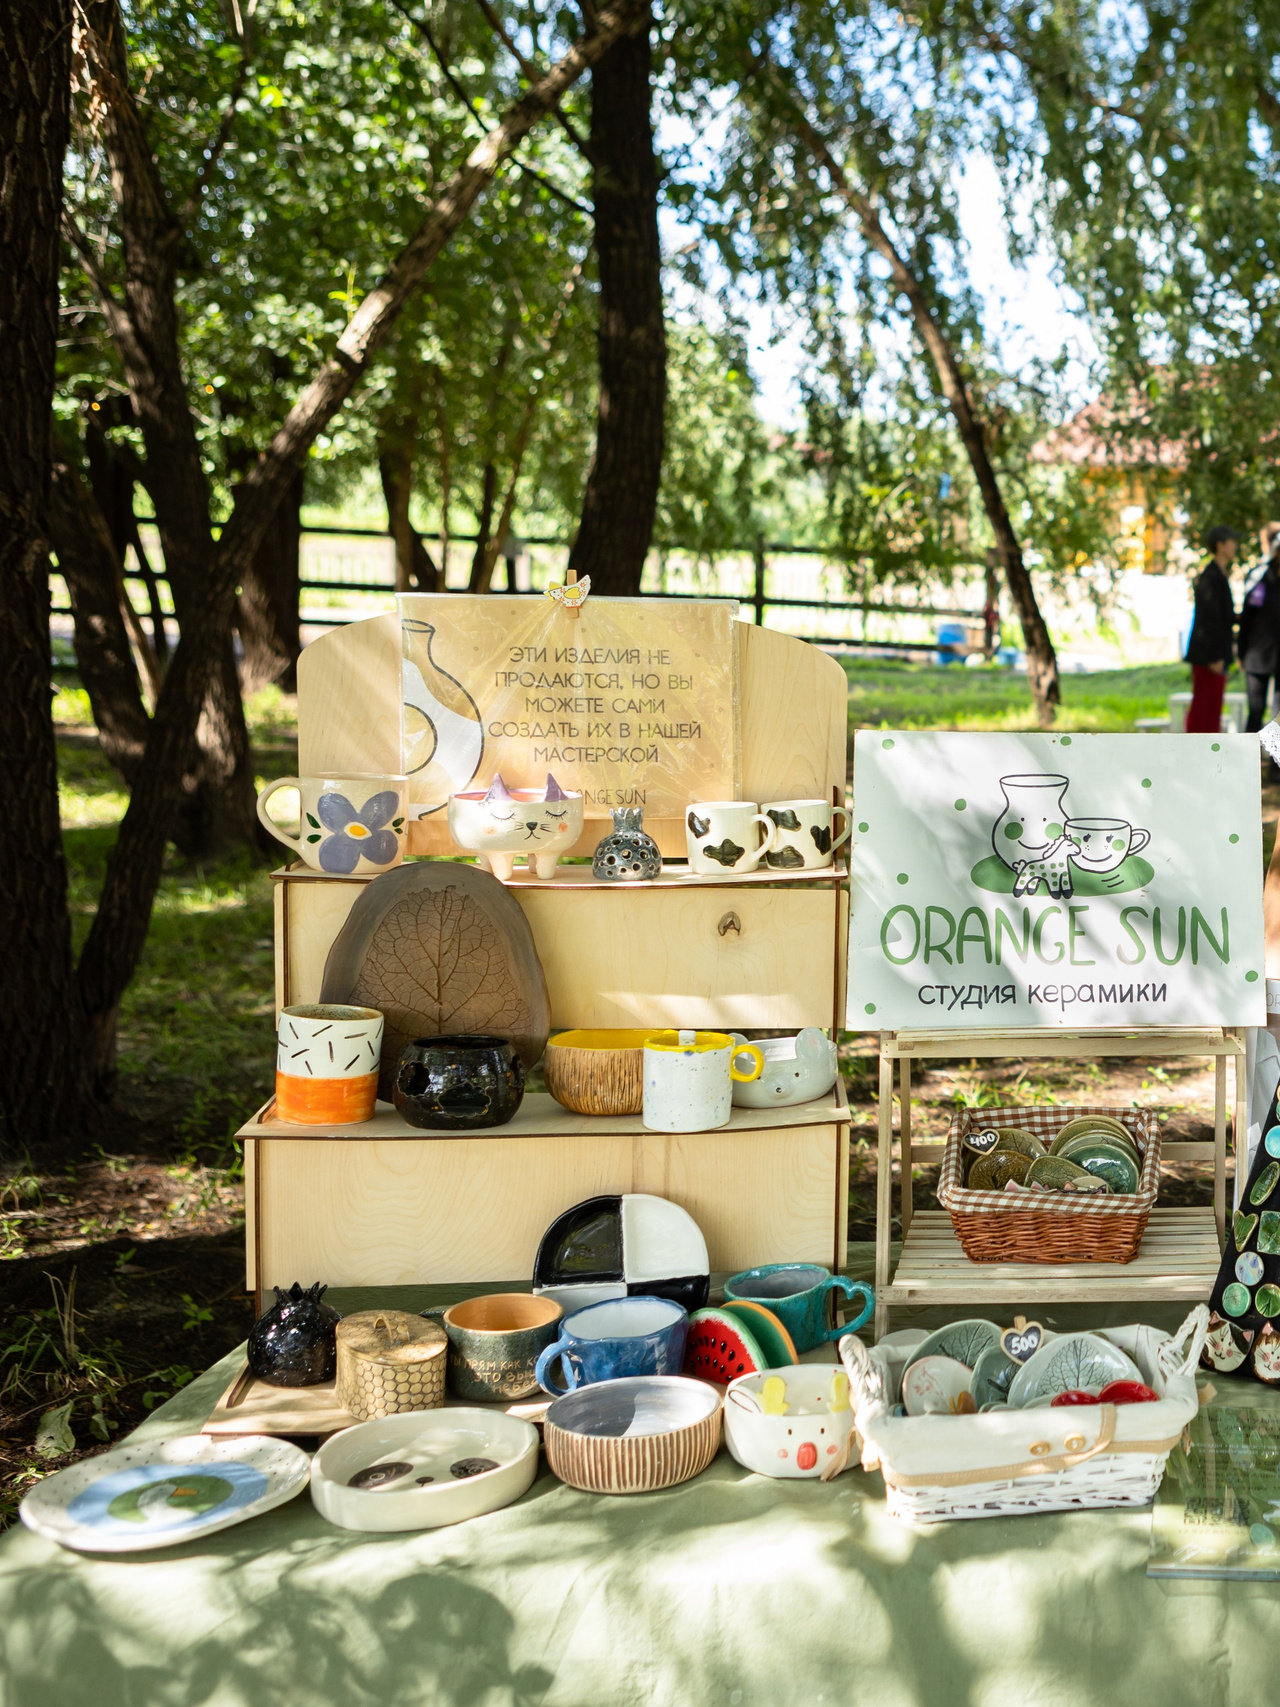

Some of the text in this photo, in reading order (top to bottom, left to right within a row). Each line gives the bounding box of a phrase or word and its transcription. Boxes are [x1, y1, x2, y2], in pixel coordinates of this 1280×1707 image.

[509, 647, 671, 665] ЭТИ ИЗДЕЛИЯ НЕ
[495, 671, 693, 690] ПРОДАЮТСЯ, НО ВЫ
[525, 697, 665, 714] МОЖЕТЕ САМИ
[488, 720, 702, 739] СОЗДАТЬ ИХ В НАШЕЙ
[534, 743, 659, 763] МАСТЕРСКОЙ
[616, 789, 646, 805] SUN
[880, 904, 1230, 967] ORANGE SUN
[918, 981, 1167, 1011] студия керамики
[969, 1131, 996, 1146] 400
[1011, 1334, 1038, 1355] 500
[500, 1359, 521, 1371] КАК
[474, 1371, 501, 1383] ЭТО
